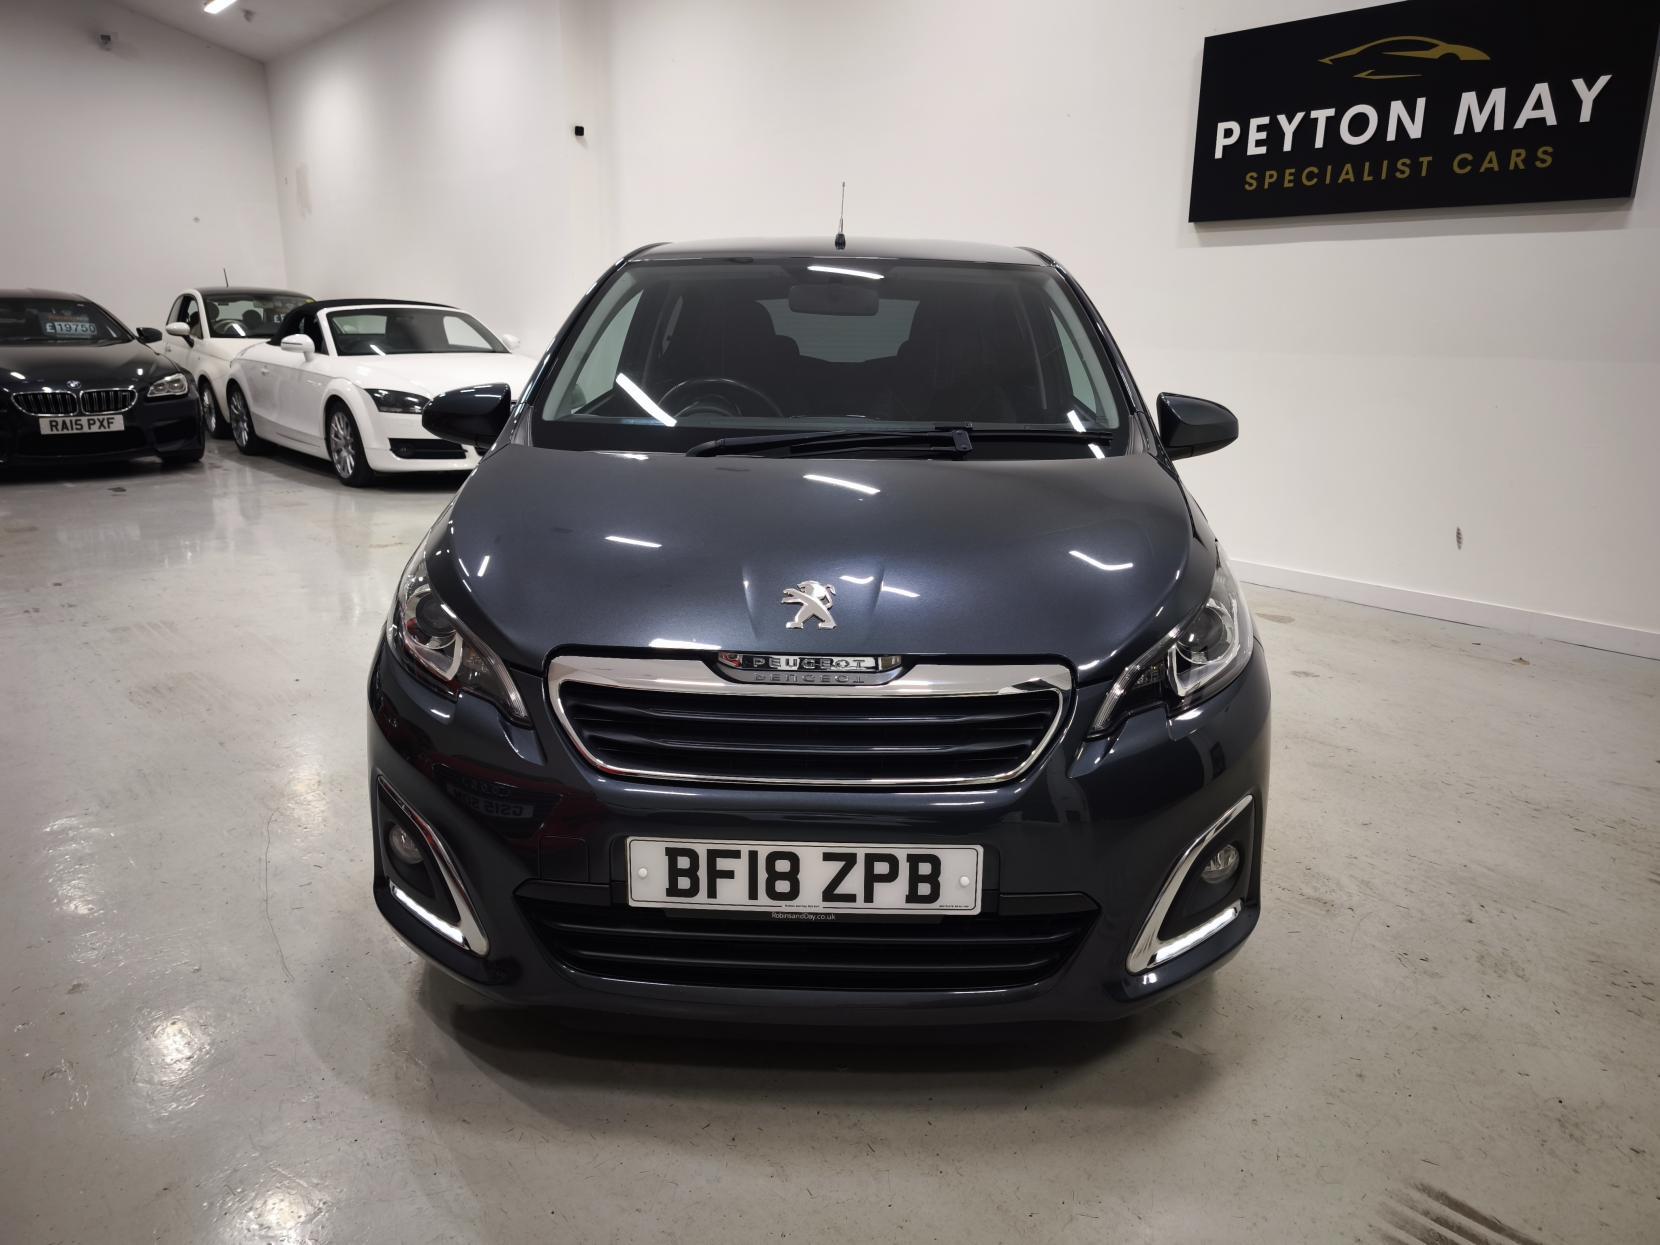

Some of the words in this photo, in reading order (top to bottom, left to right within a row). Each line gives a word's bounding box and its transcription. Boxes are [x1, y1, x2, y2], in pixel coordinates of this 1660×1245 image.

[1213, 97, 1427, 159] PEYTON
[1453, 74, 1613, 135] MAY
[1244, 156, 1434, 191] SPECIALIST
[1452, 146, 1555, 175] CARS
[49, 419, 84, 432] RA15
[87, 416, 115, 431] PXF
[752, 656, 866, 669] PEUGEOT
[664, 846, 801, 902] BF18
[821, 852, 942, 905] ZPB
